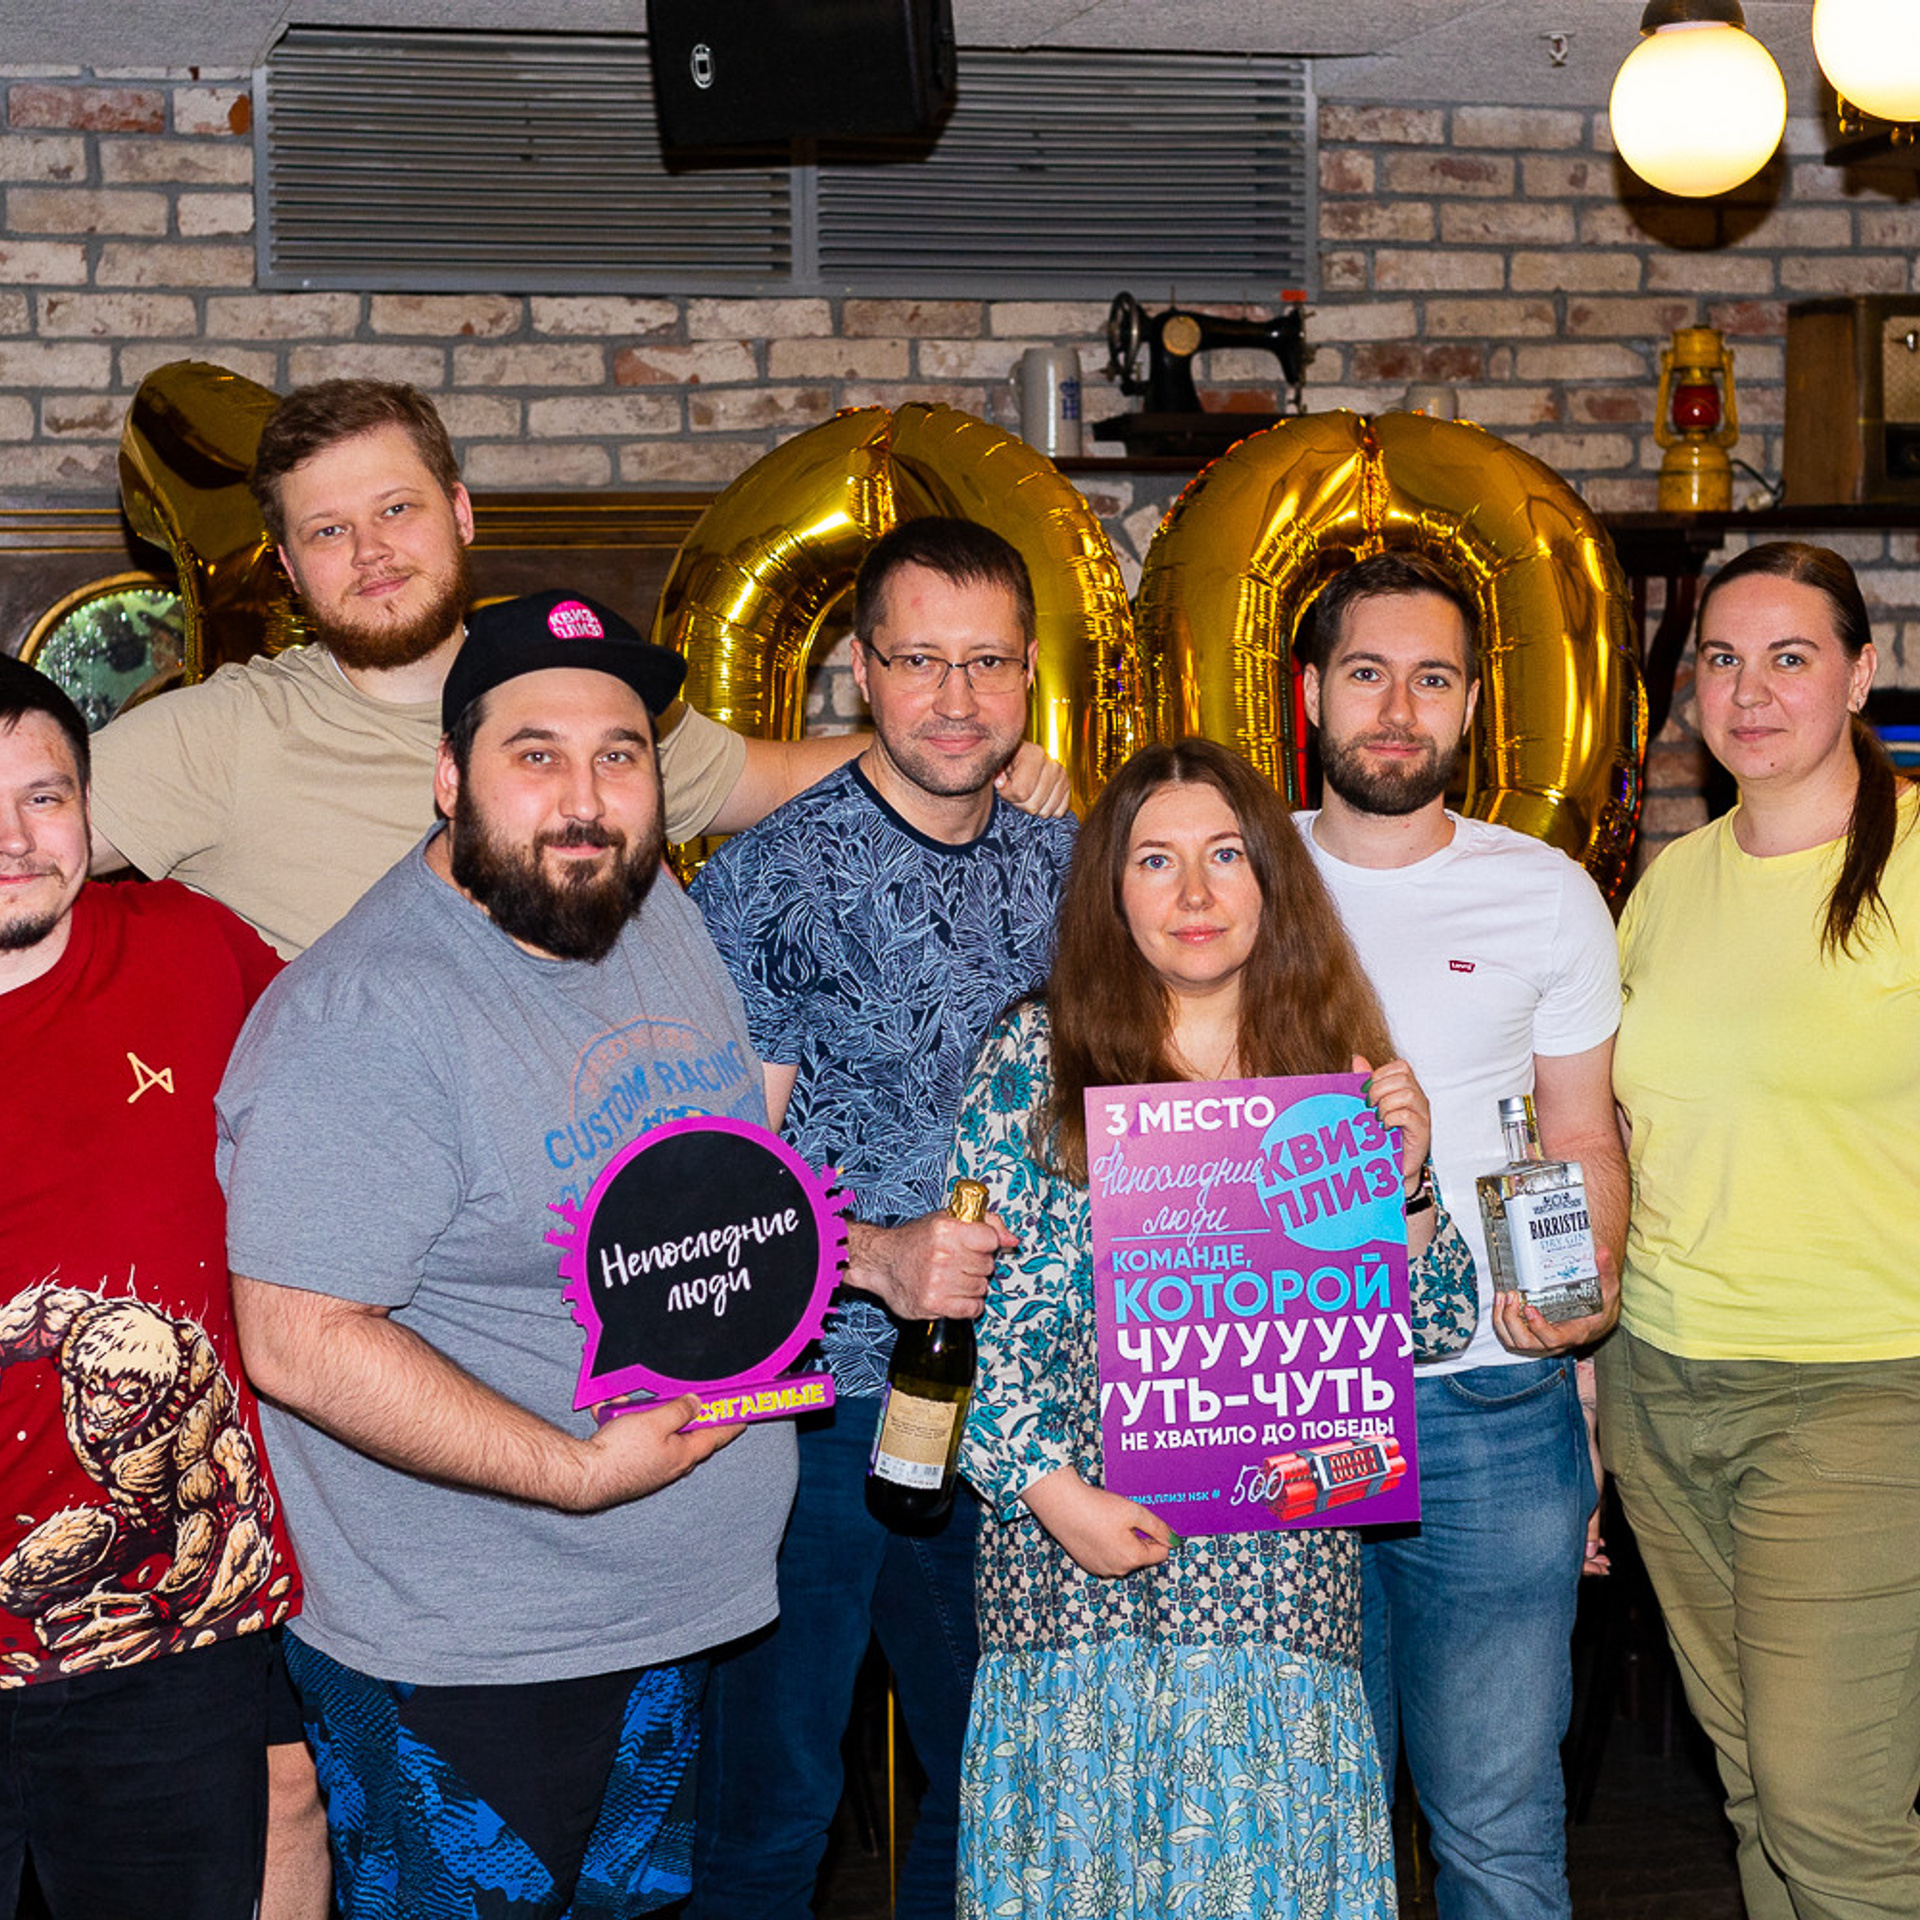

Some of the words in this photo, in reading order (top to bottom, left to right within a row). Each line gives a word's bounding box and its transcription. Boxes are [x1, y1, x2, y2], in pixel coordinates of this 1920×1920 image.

[544, 1064, 651, 1169] CUSTOM
[1105, 1103, 1127, 1136] 3
[1138, 1096, 1276, 1134] МЕСТО
[1142, 1203, 1230, 1248] люди
[1529, 1210, 1591, 1239] BARRISTER
[600, 1208, 800, 1289] Непоследние
[1111, 1244, 1253, 1273] КОМАНДЕ,
[667, 1267, 751, 1317] люди
[1114, 1252, 1392, 1324] КОТОРОЙ
[1121, 1431, 1149, 1451] НЕ
[1153, 1425, 1257, 1449] ХВАТИЛО
[1261, 1423, 1297, 1445] ДО
[1301, 1416, 1395, 1440] ПОБЕДЫ
[1230, 1465, 1285, 1507] 500
